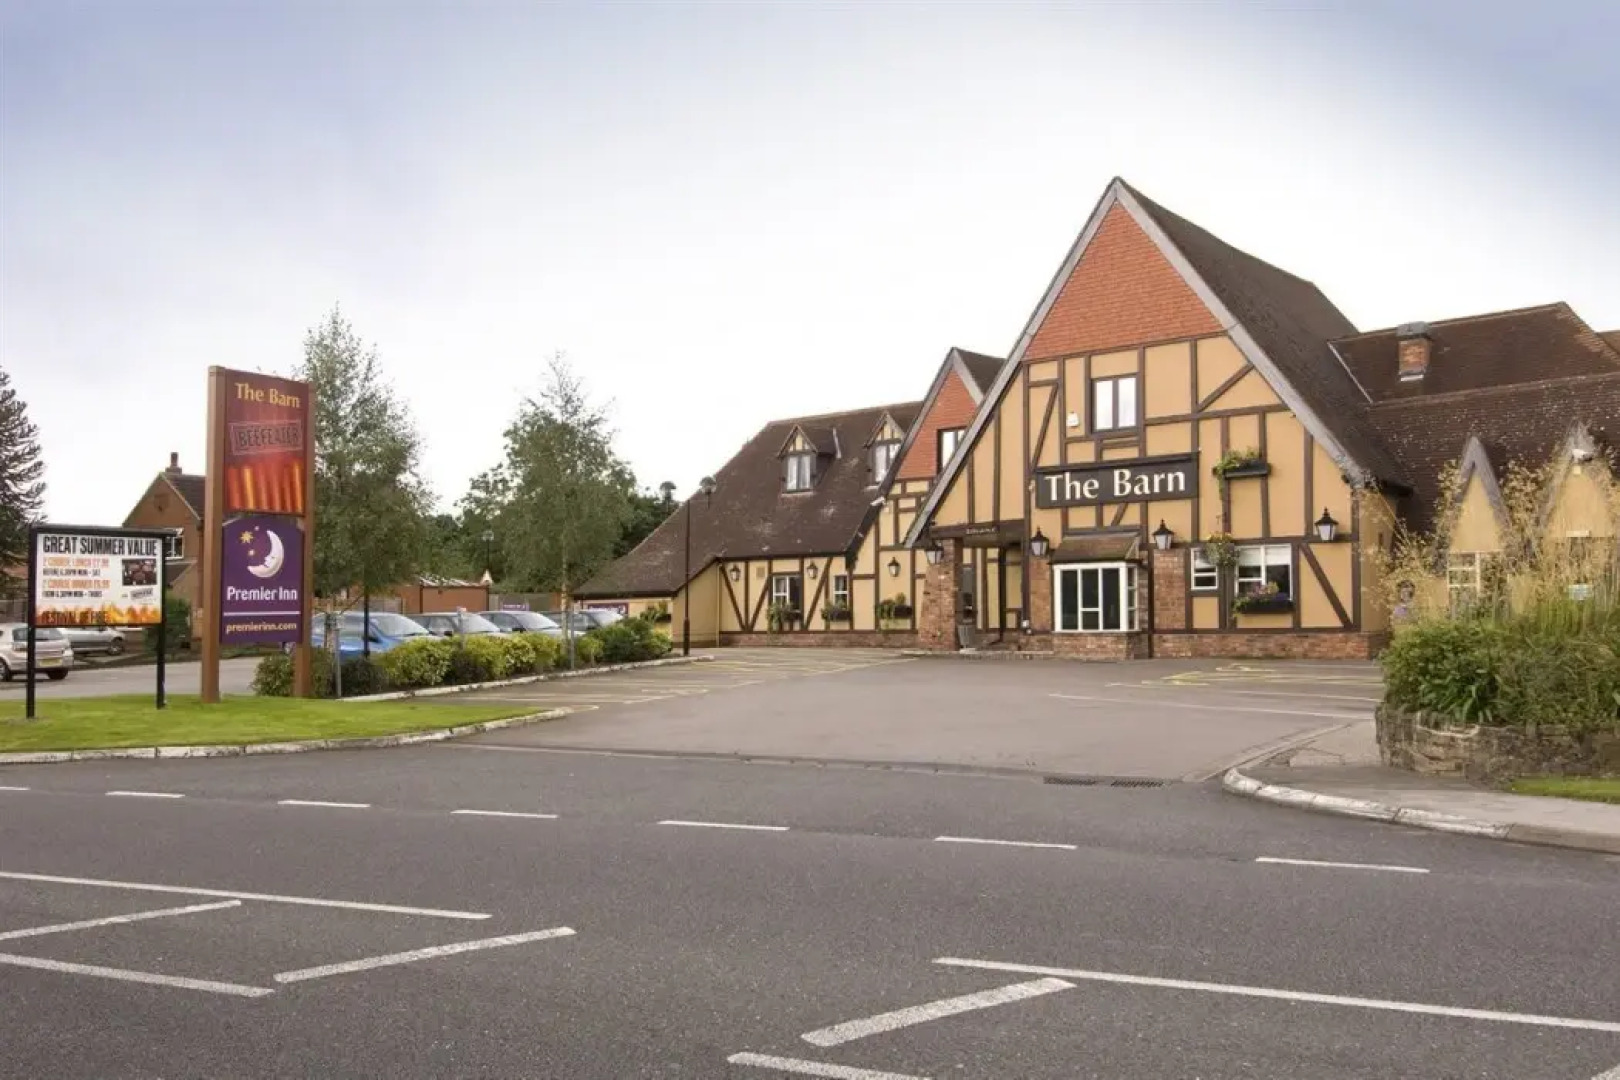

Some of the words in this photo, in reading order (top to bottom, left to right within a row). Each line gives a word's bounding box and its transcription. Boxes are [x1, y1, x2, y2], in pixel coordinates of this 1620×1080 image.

[234, 382, 265, 402] The
[269, 388, 301, 408] Barn
[238, 426, 299, 448] BEEFEATER
[1044, 472, 1100, 501] The
[1113, 468, 1186, 497] Barn
[43, 536, 78, 554] GREAT
[80, 537, 125, 555] SUMMER
[127, 539, 158, 556] VALUE
[226, 586, 278, 601] Premier
[279, 586, 298, 601] Inn
[225, 621, 297, 635] premierinn.com
